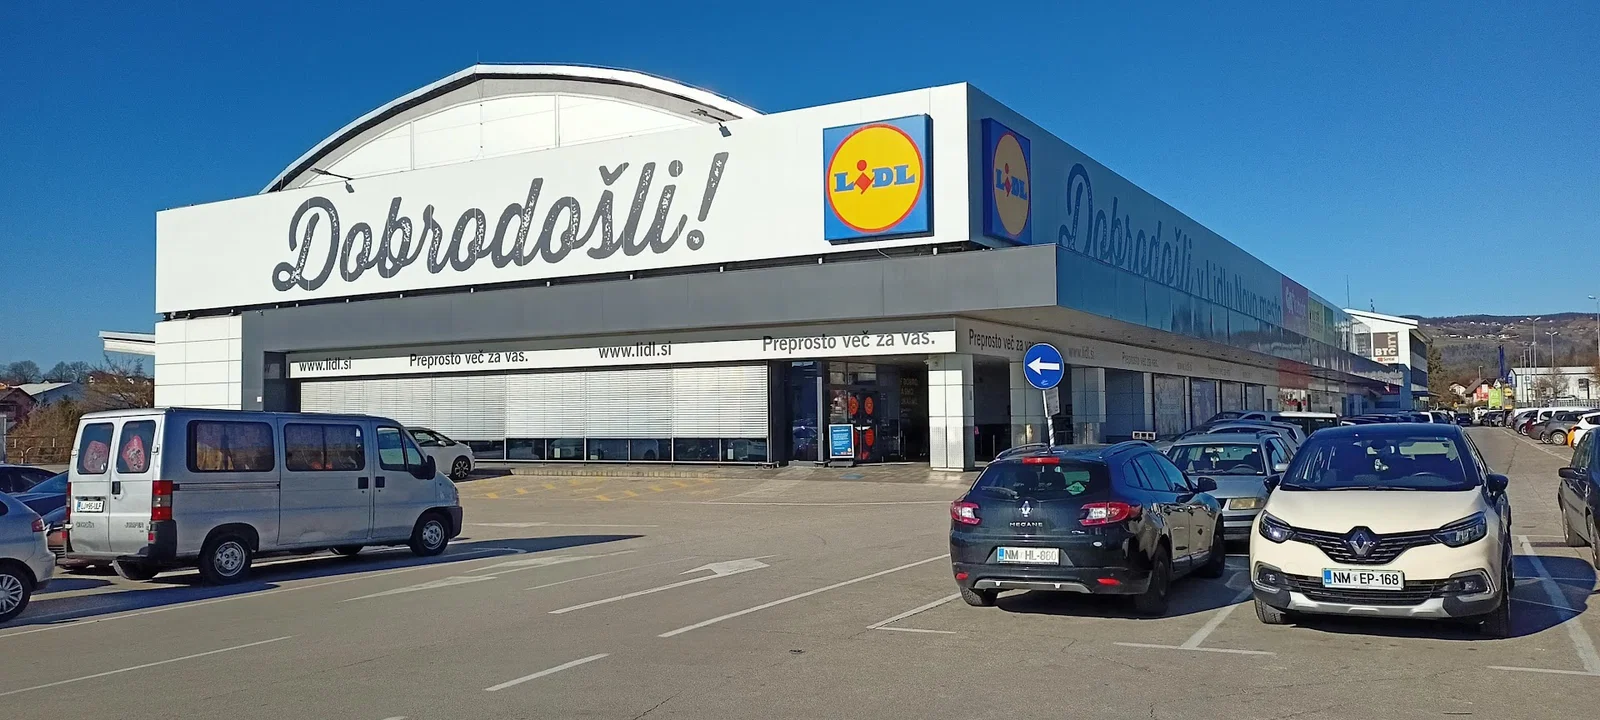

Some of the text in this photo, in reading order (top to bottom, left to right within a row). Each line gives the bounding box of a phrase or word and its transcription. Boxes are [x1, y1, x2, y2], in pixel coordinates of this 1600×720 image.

[834, 160, 915, 195] LIDL
[996, 163, 1027, 199] LIDL
[272, 151, 729, 292] Dobrodošli!
[598, 341, 672, 359] www.lidl.si
[762, 330, 936, 354] Preprosto več za vas.
[968, 328, 1001, 351] Preprosto
[1003, 334, 1014, 351] več
[1016, 339, 1024, 352] za
[409, 349, 528, 369] Preprosto več za vas.
[1374, 348, 1396, 356] BTC
[299, 356, 352, 372] www.lidl.si
[1005, 549, 1057, 561] NM HL-860
[1333, 572, 1399, 586] NM EP-168
